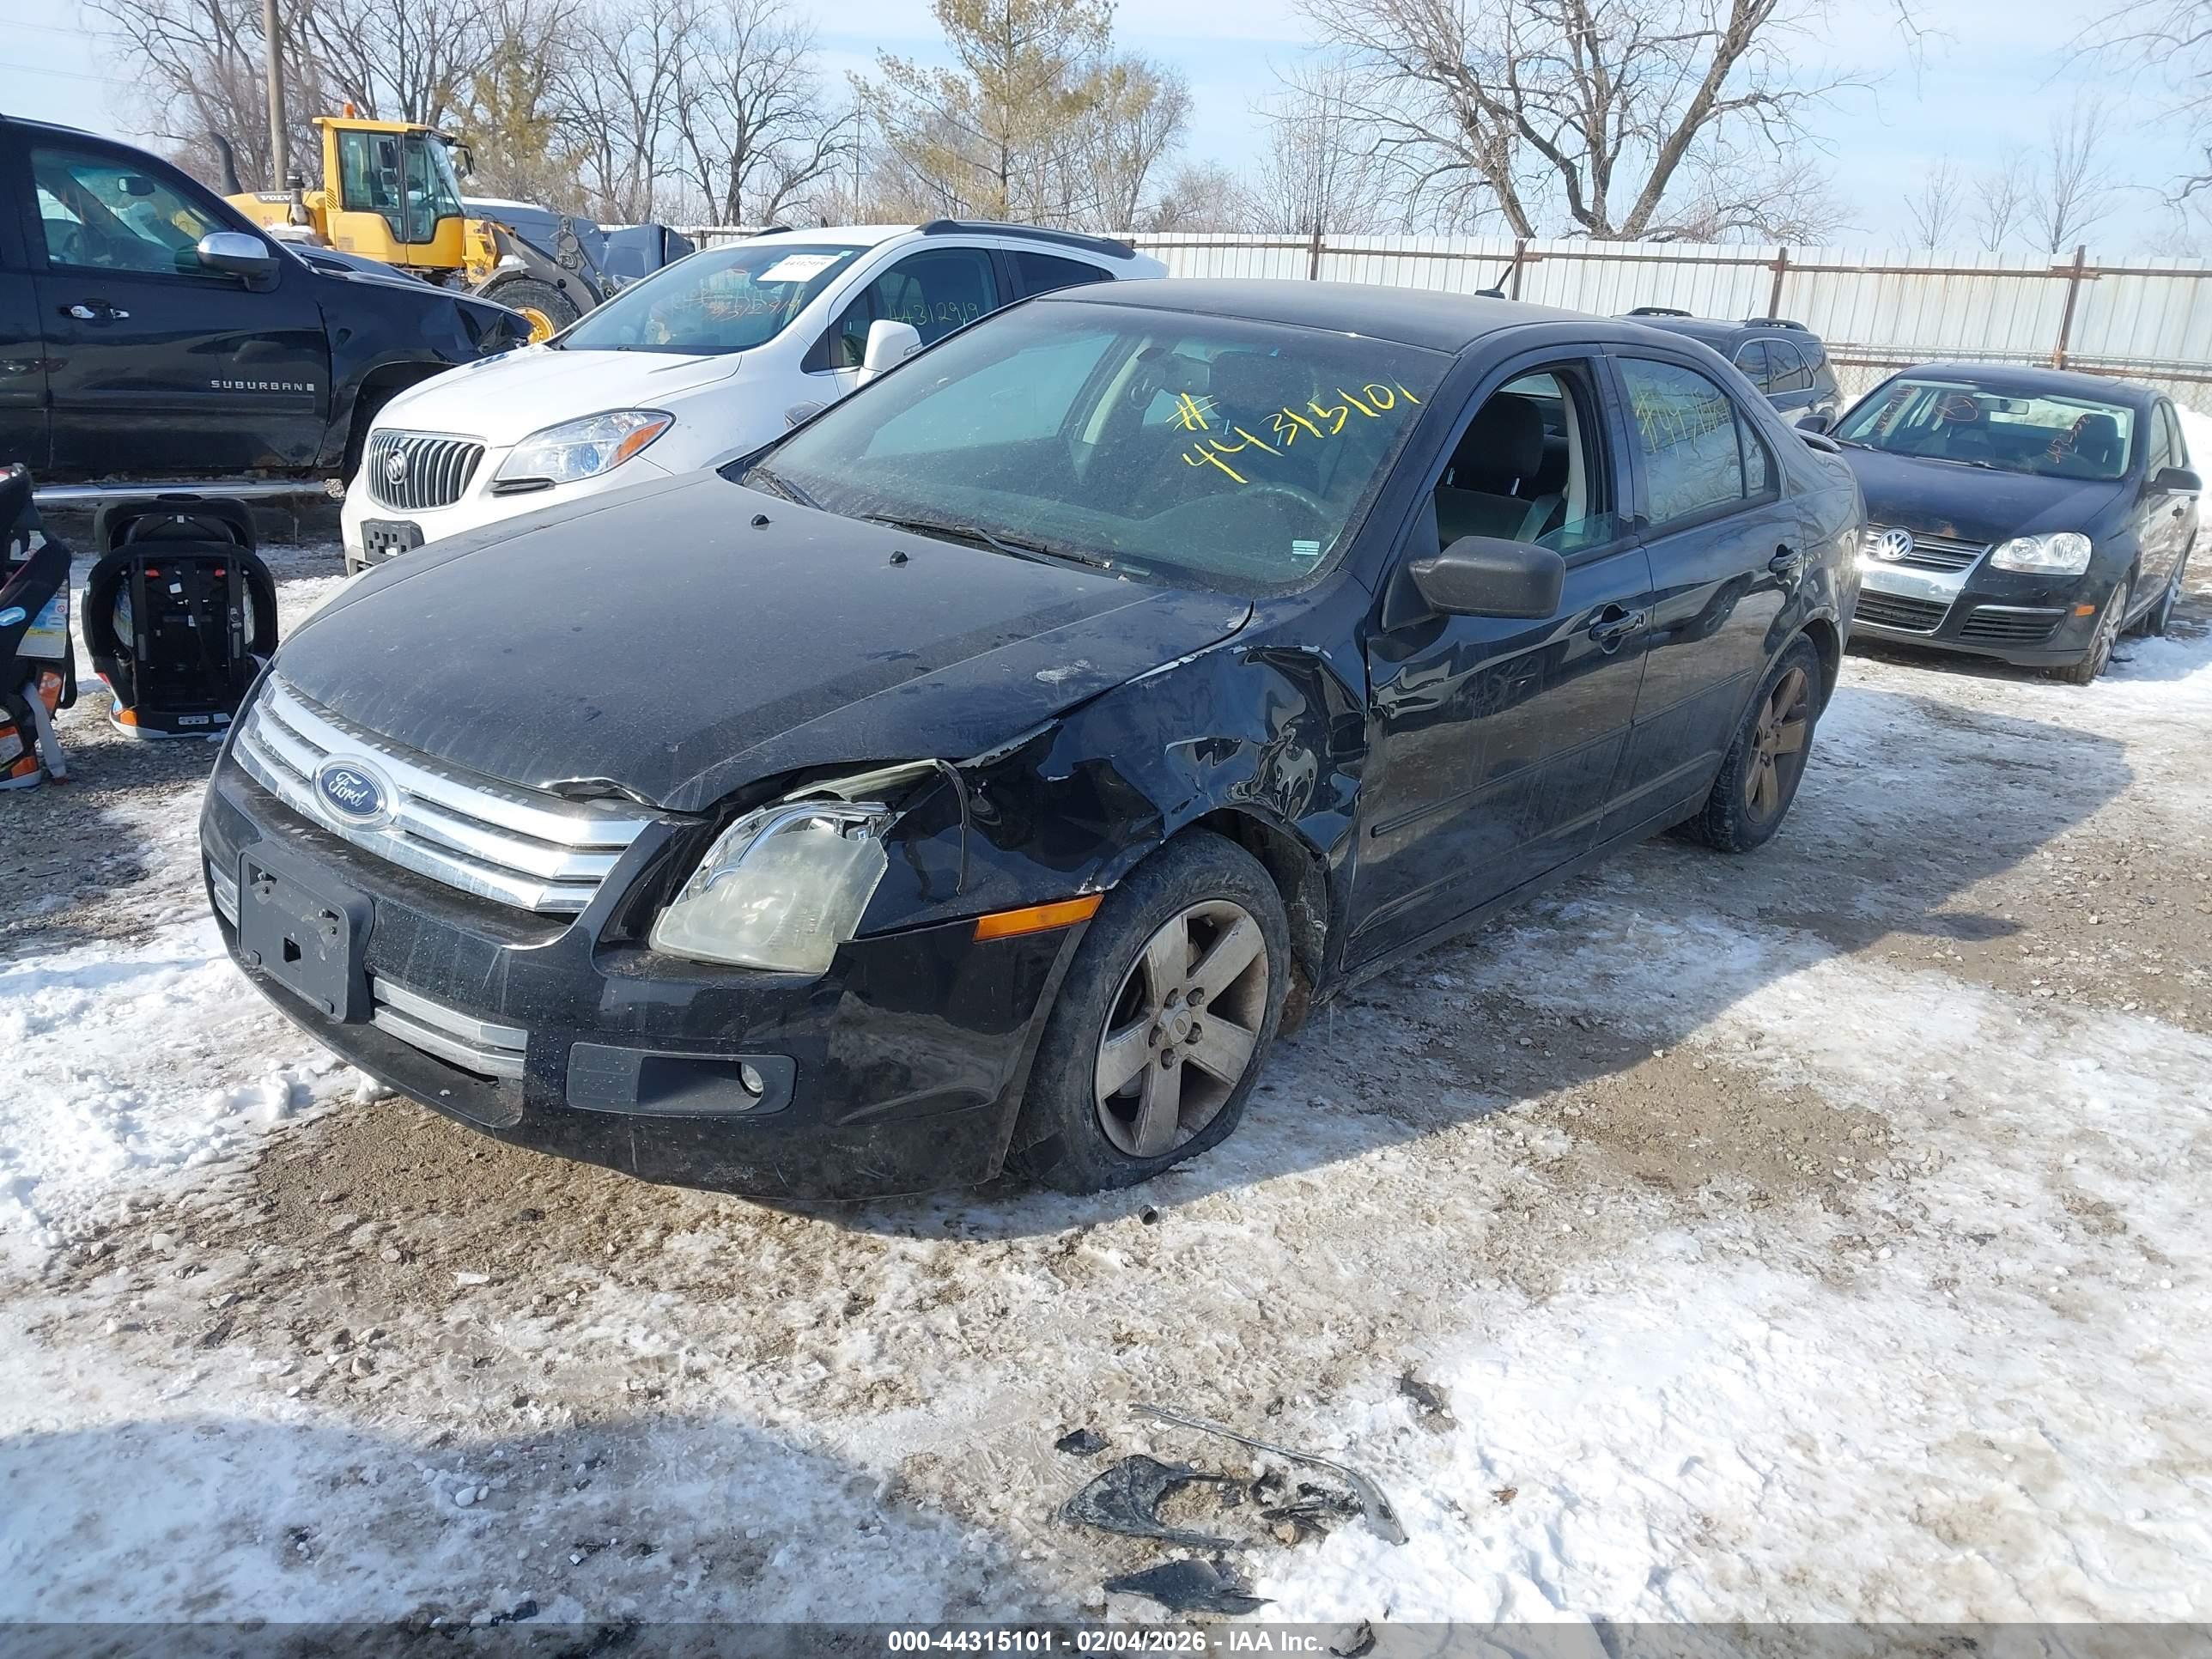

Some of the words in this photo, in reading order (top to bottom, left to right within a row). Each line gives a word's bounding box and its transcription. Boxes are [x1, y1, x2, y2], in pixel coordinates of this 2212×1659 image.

[888, 302, 980, 325] 44312919
[210, 380, 303, 392] SUBURBAN
[1182, 374, 1423, 484] 44315101
[328, 771, 369, 807] Ford
